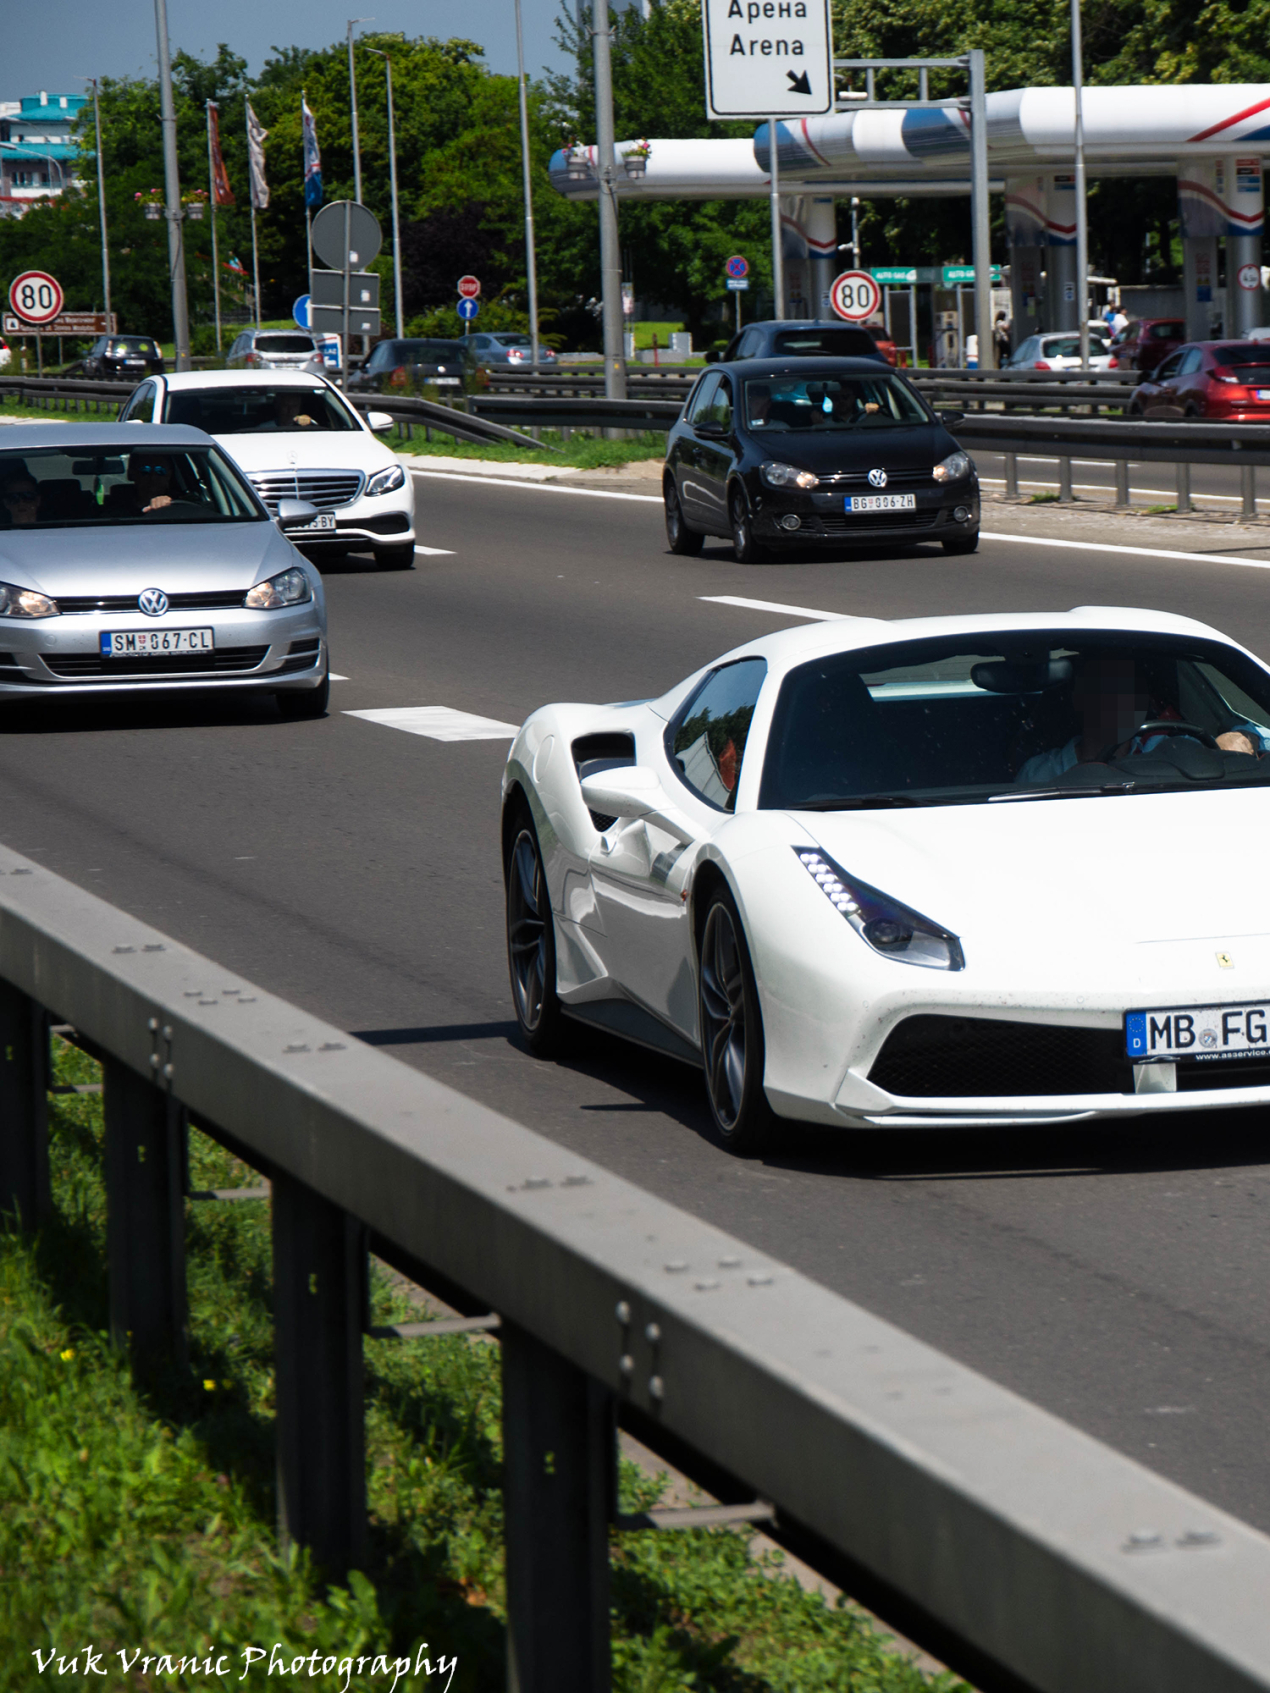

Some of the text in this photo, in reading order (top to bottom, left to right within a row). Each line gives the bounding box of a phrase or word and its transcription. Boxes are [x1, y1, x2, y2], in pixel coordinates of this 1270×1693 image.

[728, 0, 807, 24] Арена
[729, 33, 804, 55] Arena
[875, 271, 892, 279] AUTO
[948, 271, 965, 279] AUTO
[460, 282, 477, 292] STOP
[21, 284, 52, 310] 80
[841, 284, 870, 309] 80
[853, 497, 868, 510] BG
[114, 633, 136, 651] SM
[1150, 1014, 1196, 1050] MB
[1222, 1009, 1266, 1045] FG
[1133, 1038, 1141, 1048] D
